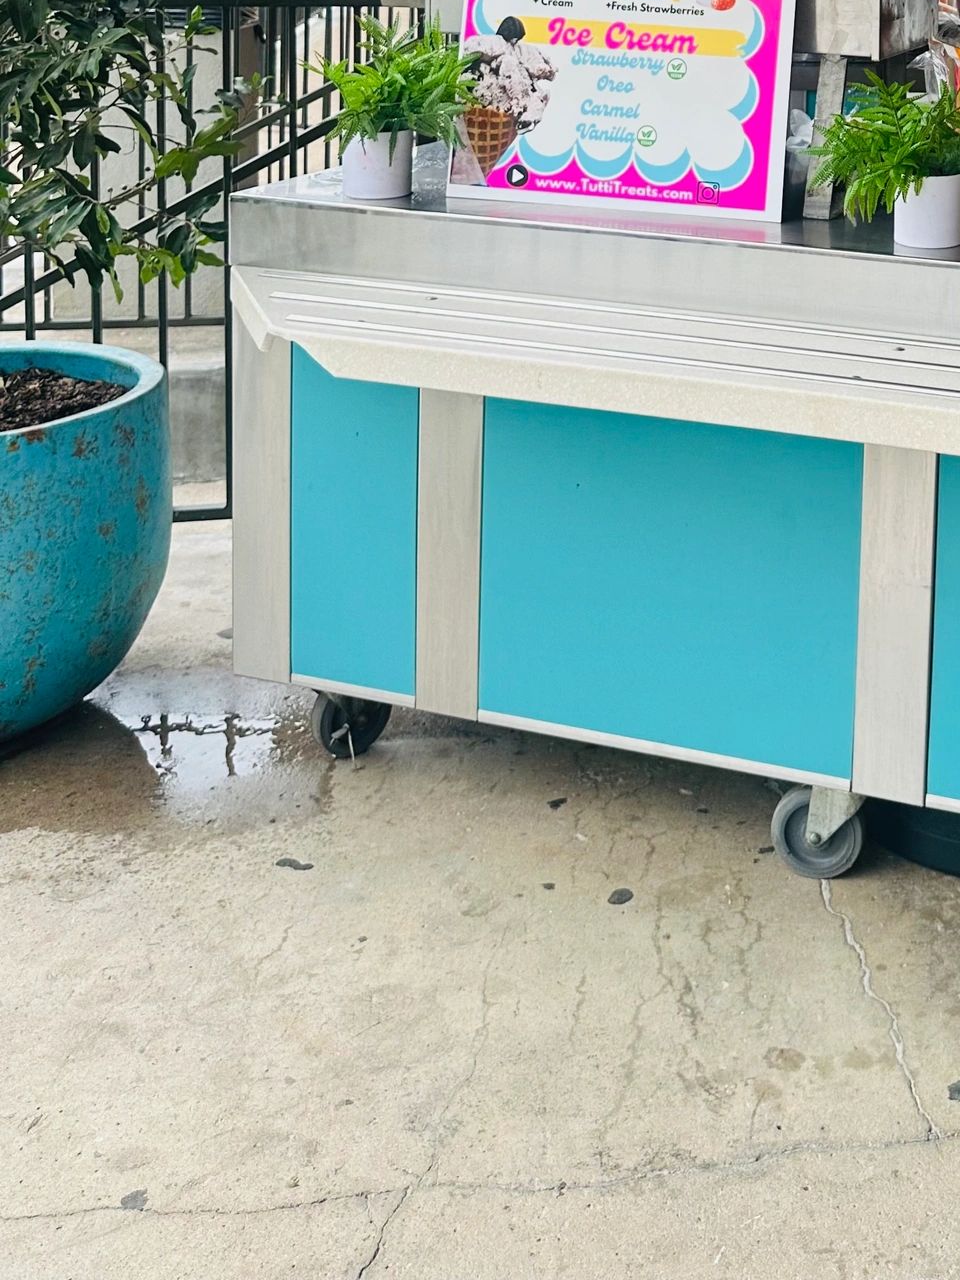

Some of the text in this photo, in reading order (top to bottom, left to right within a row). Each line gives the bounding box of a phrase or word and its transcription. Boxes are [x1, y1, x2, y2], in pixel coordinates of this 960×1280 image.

[640, 3, 705, 16] Strawberries
[548, 17, 699, 54] Ice Cream
[571, 48, 665, 76] Strawberry
[597, 75, 635, 94] Oreo
[581, 99, 641, 119] Carmel
[576, 123, 637, 144] Vanilla
[535, 178, 693, 201] www.TuttiTreats.com
